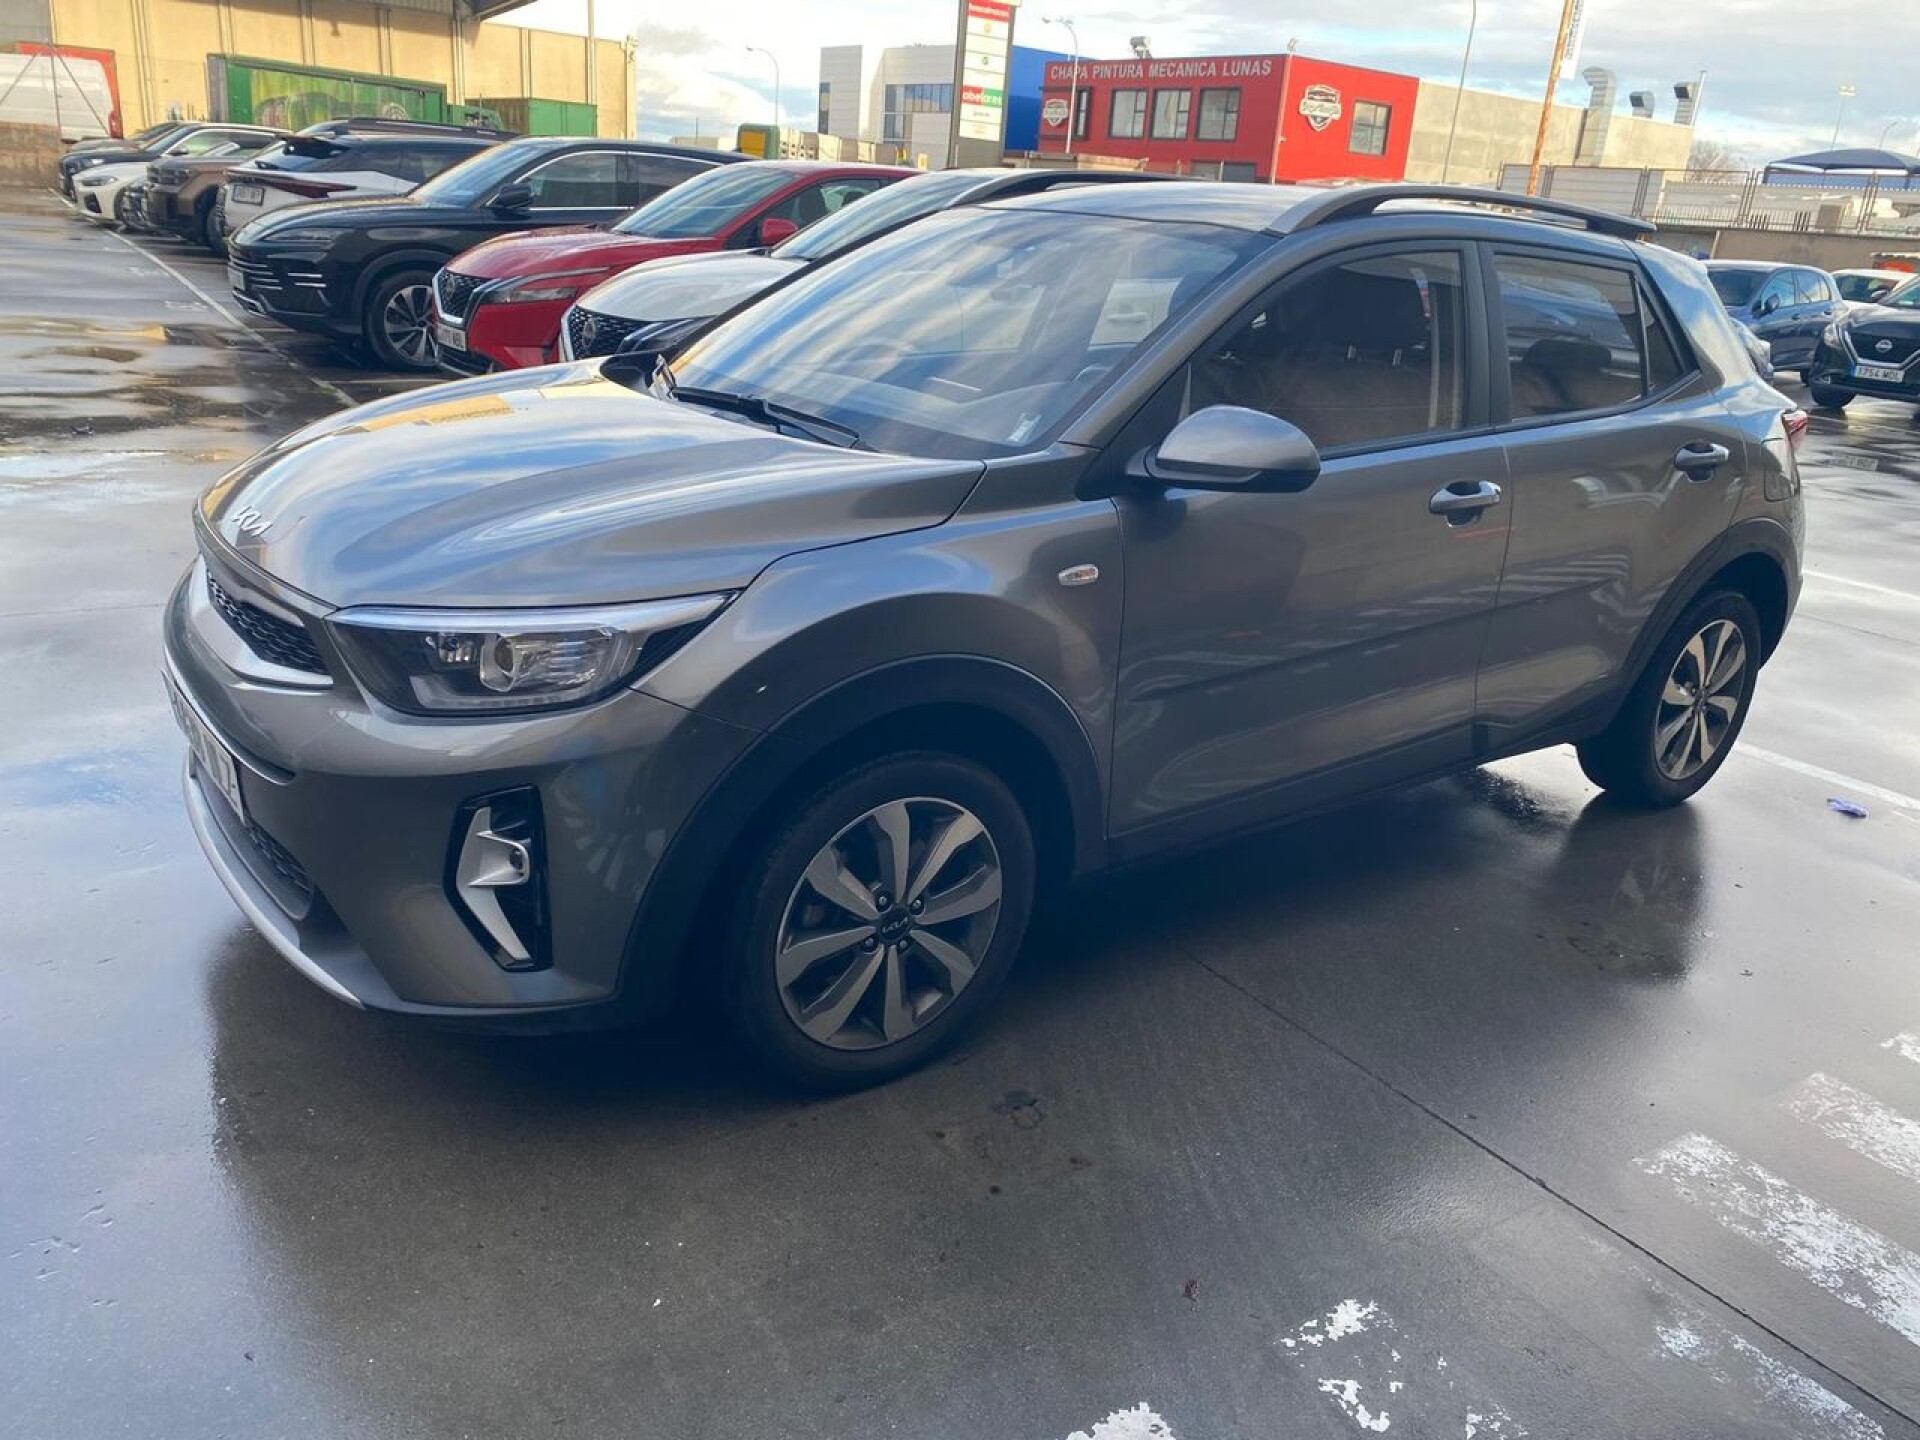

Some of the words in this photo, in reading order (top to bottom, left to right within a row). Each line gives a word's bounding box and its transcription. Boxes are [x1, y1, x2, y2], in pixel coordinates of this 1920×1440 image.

[1051, 65, 1088, 79] CHAPA
[1092, 64, 1143, 79] PINTURA
[1148, 62, 1216, 78] MECANICA
[1222, 60, 1273, 76] LUNAS
